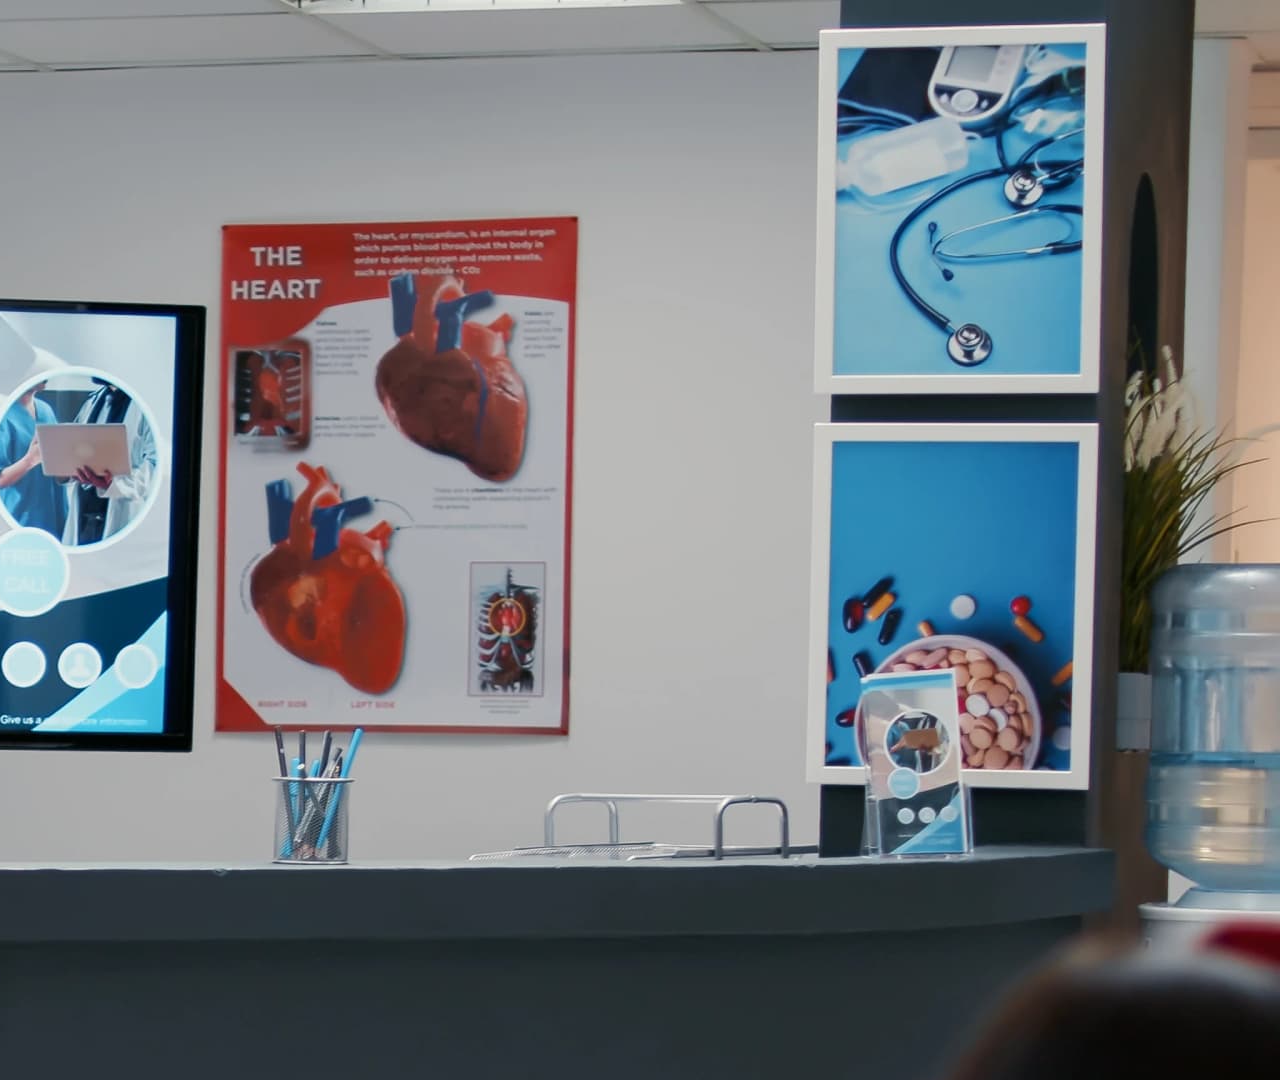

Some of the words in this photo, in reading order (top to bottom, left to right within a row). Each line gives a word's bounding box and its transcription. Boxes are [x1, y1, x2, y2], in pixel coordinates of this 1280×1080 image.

[352, 233, 370, 241] The
[371, 232, 397, 241] heart,
[480, 230, 491, 238] an
[492, 228, 528, 237] internal
[528, 229, 557, 238] organ
[353, 243, 380, 252] which
[381, 244, 412, 254] pumps
[413, 242, 440, 252] blood
[441, 241, 492, 251] throughout
[492, 241, 508, 249] the
[509, 240, 534, 250] body
[535, 240, 544, 249] in
[249, 245, 302, 267] THE
[353, 256, 379, 264] order
[380, 256, 391, 264] to
[392, 255, 423, 264] deliver
[424, 255, 458, 265] oxygen
[459, 254, 477, 263] and
[478, 254, 512, 263] remove
[353, 268, 376, 277] such
[376, 269, 387, 277] as
[231, 278, 322, 301] HEART
[351, 700, 373, 709] LEFT
[0, 713, 21, 725] Give
[23, 716, 34, 725] us
[35, 716, 42, 725] a
